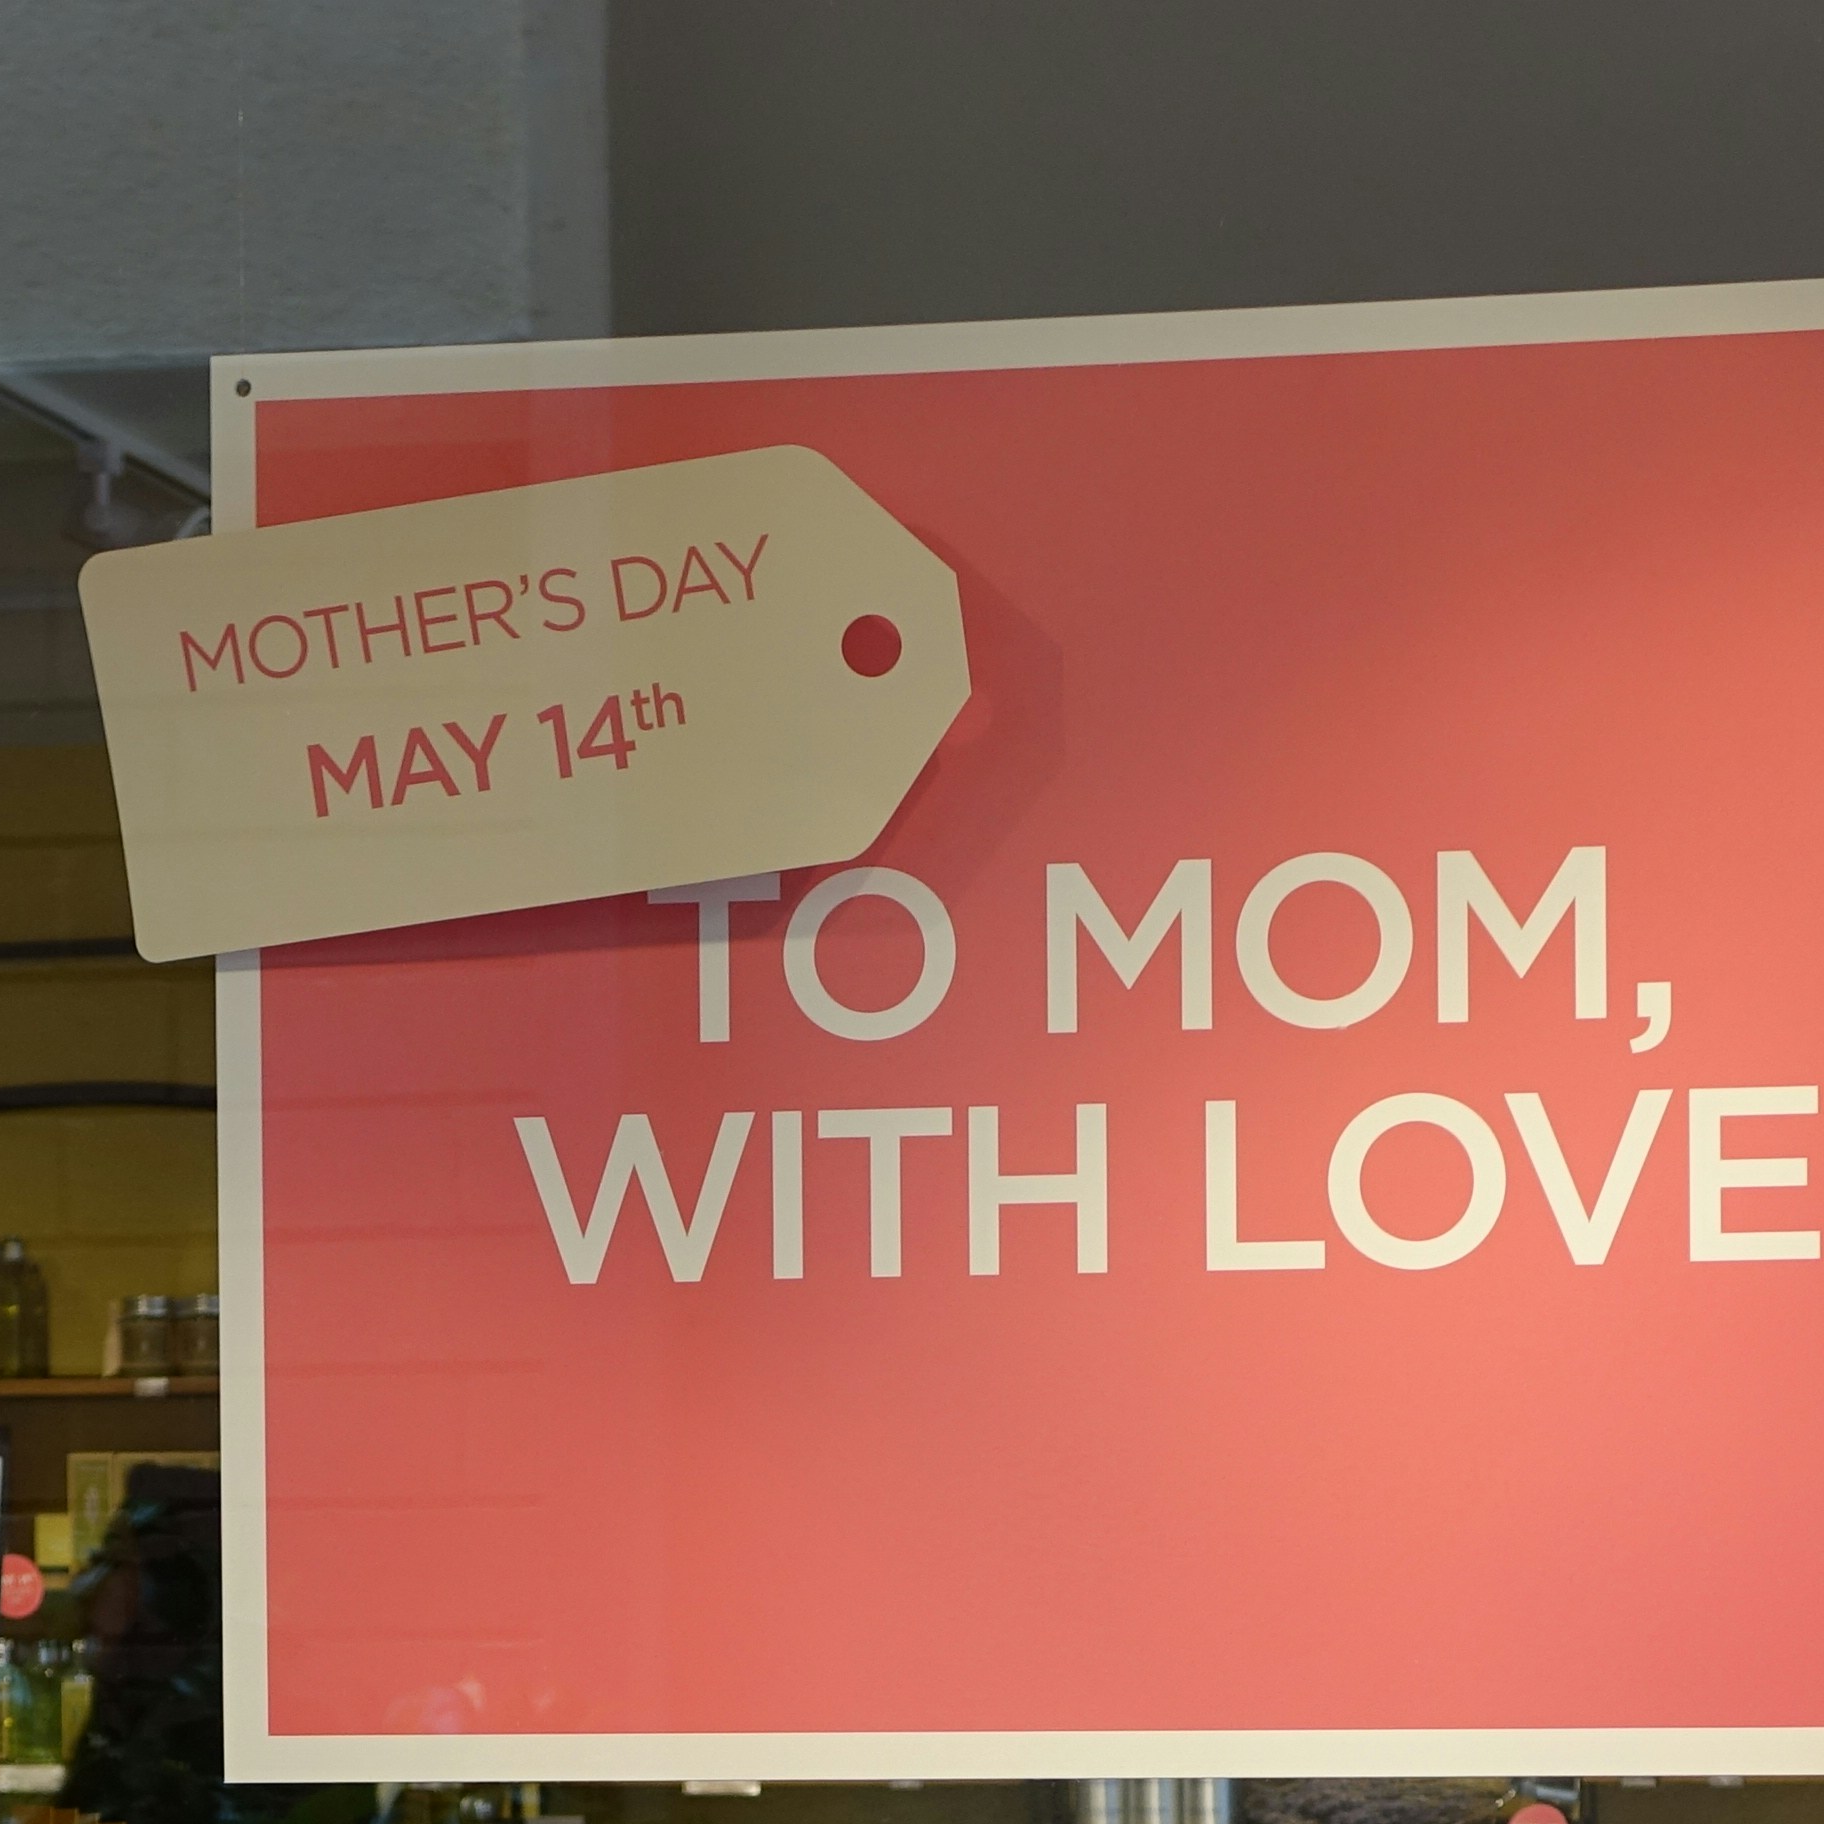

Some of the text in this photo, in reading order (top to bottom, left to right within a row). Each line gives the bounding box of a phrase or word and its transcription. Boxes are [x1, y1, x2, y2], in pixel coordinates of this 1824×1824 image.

[180, 533, 770, 693] MOTHER'S DAY
[306, 682, 688, 819] MAY 14th
[646, 844, 1674, 1055] TO MOM,
[512, 1083, 1822, 1284] WITH LOVE
